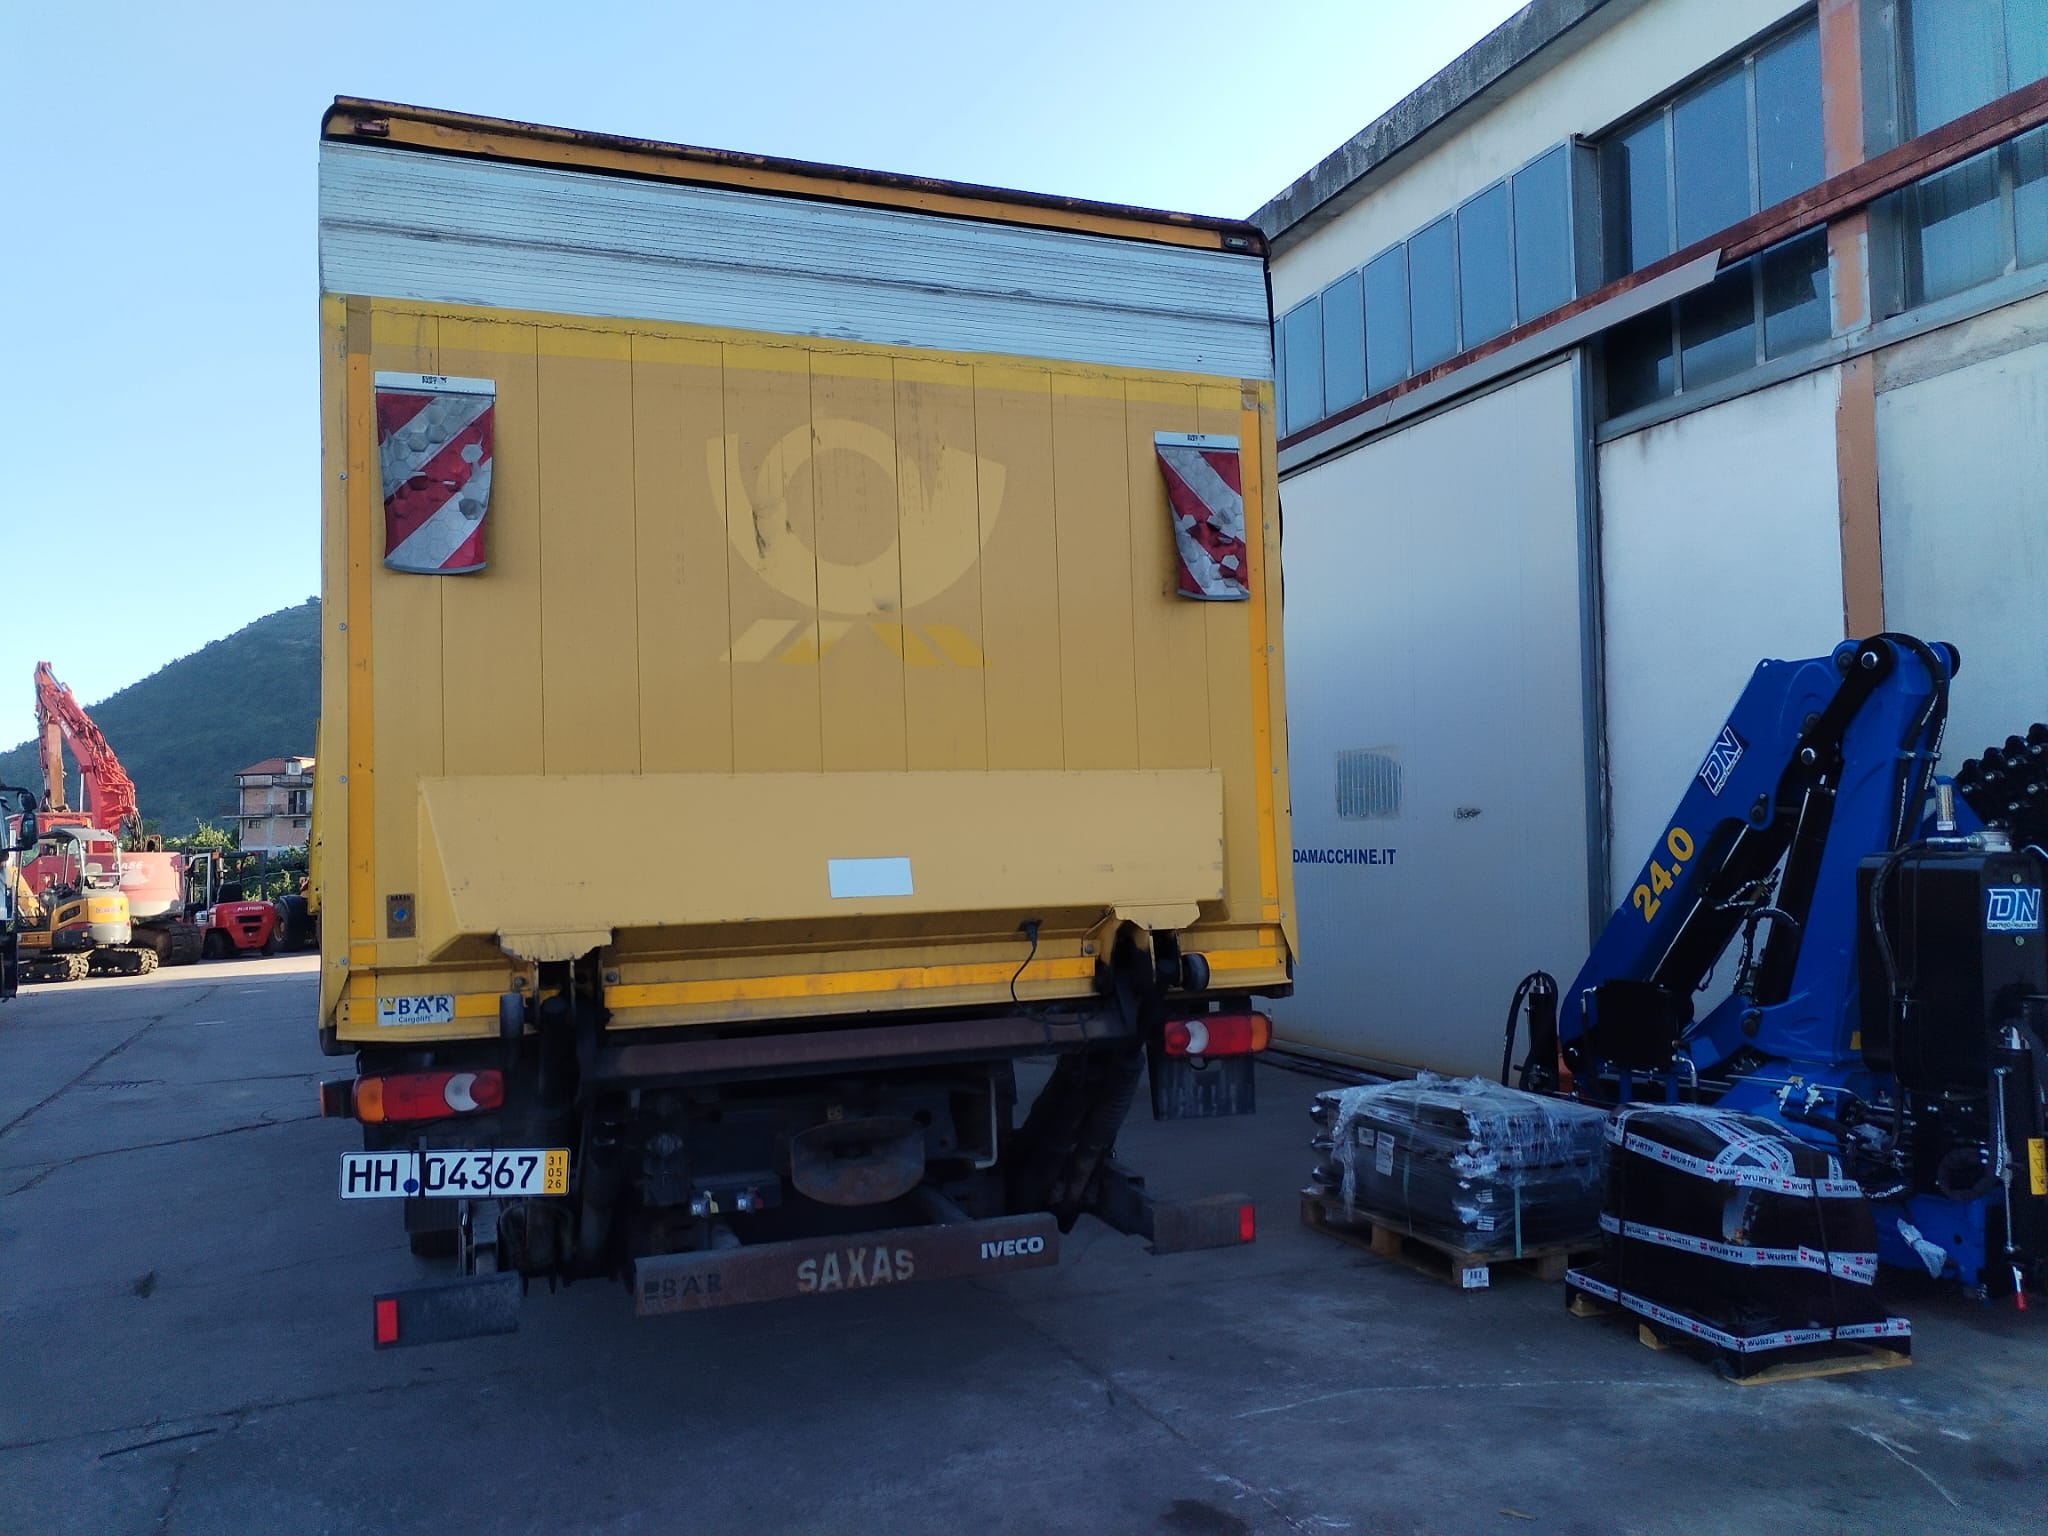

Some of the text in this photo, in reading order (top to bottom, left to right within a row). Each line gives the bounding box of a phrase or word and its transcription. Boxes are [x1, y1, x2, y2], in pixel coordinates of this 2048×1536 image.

[1699, 725, 1741, 793] DN
[1633, 826, 1694, 923] 24.0
[1987, 888, 2041, 922] DN
[348, 1156, 538, 1193] HH 04367
[548, 1156, 563, 1166] 31
[548, 1167, 563, 1177] 05
[547, 1179, 563, 1189] 26
[980, 1236, 1045, 1260] IVECO
[797, 1246, 915, 1293] SAXAS
